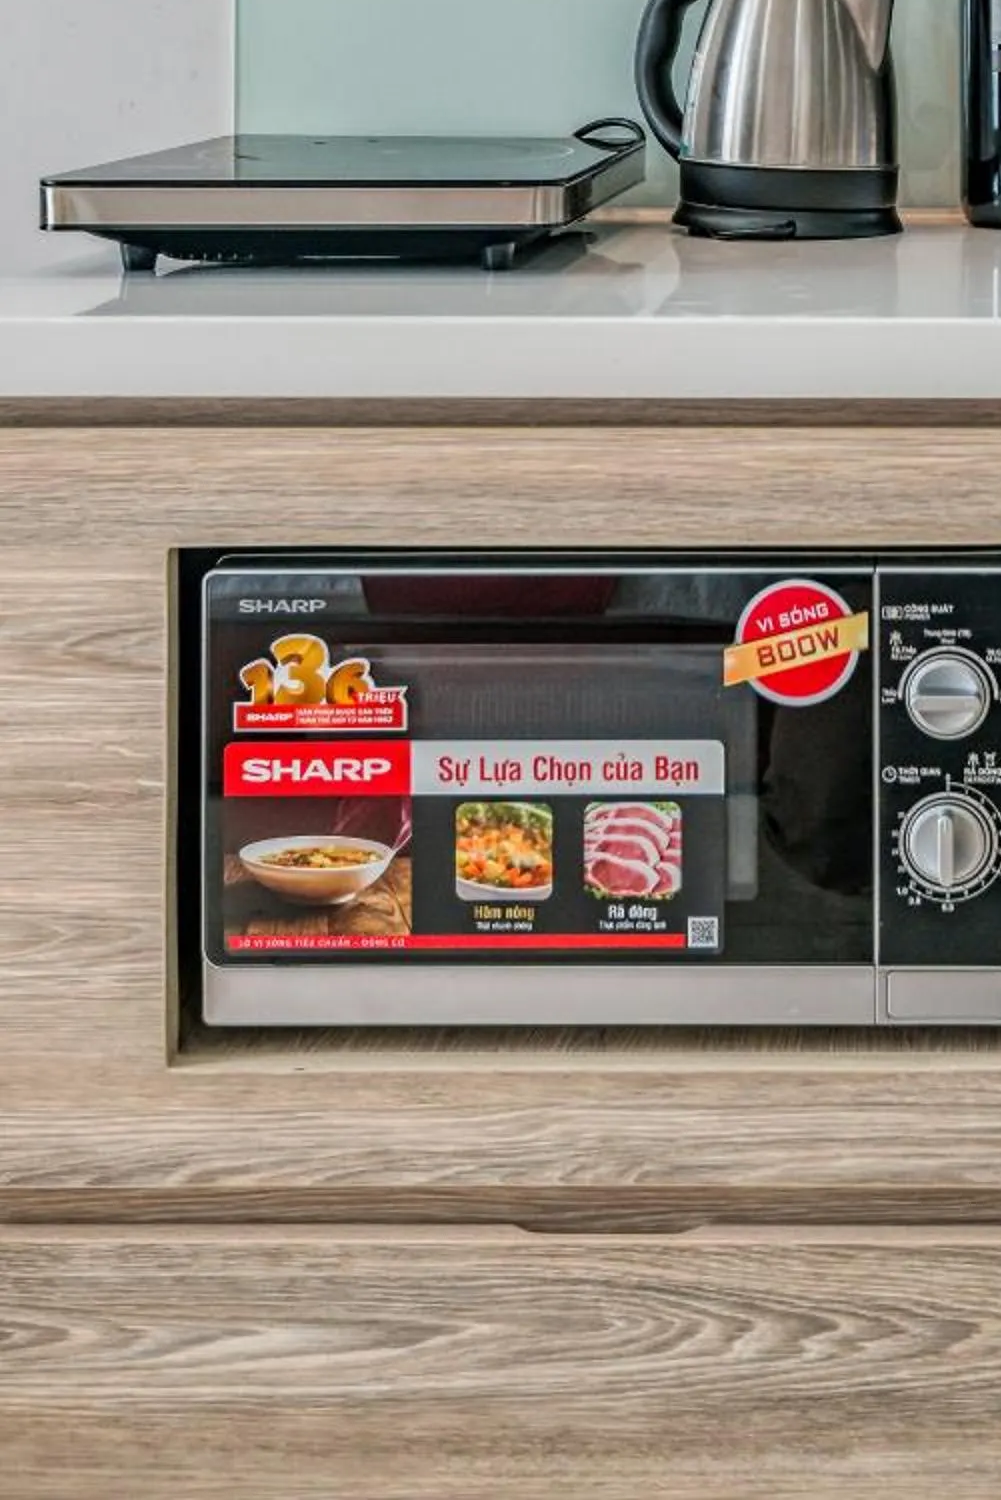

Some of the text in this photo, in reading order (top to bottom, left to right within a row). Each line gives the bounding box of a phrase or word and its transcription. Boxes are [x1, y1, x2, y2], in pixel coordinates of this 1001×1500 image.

[239, 599, 327, 613] SHARP
[757, 603, 829, 632] VI SÓNG
[757, 627, 839, 668] 800W
[242, 758, 392, 782] SHARP
[438, 753, 699, 787] Sự Lựa Chọn của Bạn
